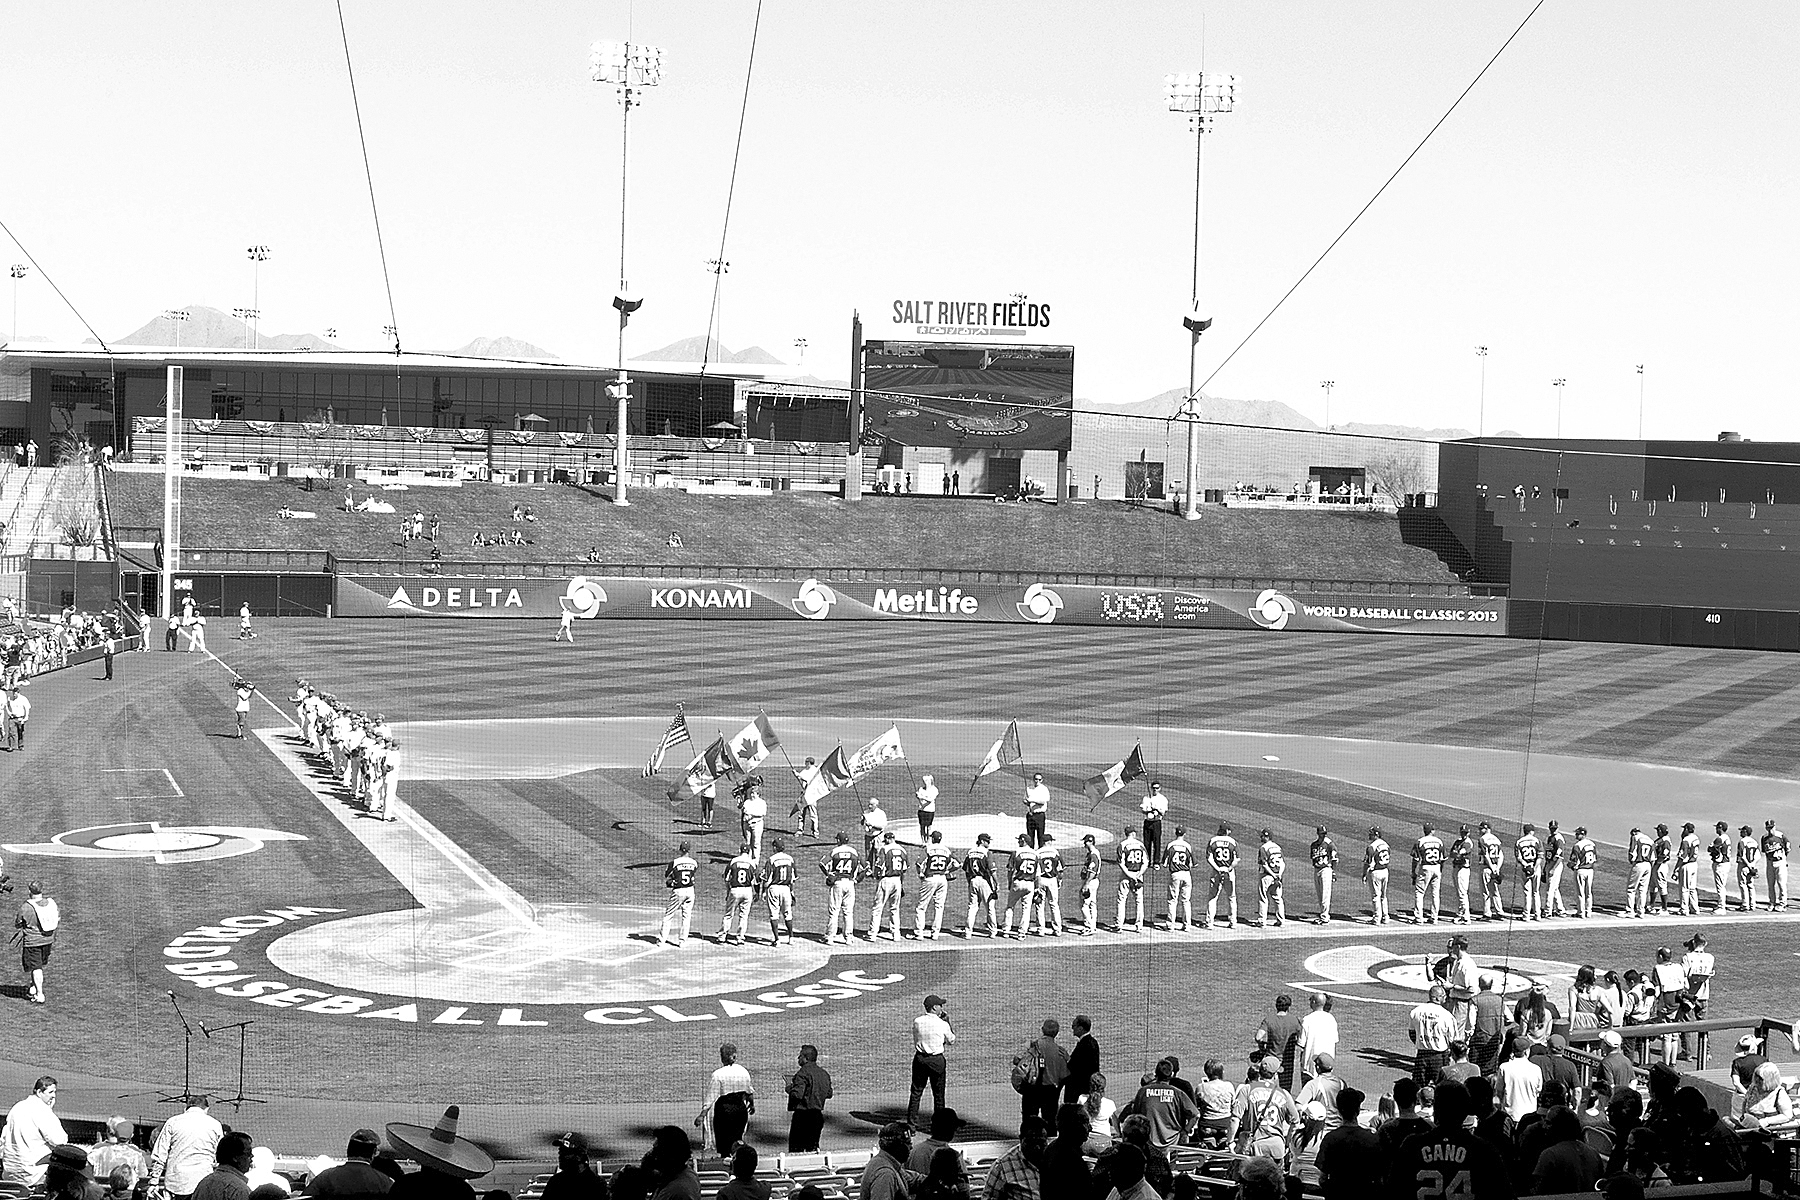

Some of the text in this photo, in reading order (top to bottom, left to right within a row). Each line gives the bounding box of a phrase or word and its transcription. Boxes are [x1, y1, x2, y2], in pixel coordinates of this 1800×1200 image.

[892, 300, 1051, 328] SALT RIVER FIELDS
[173, 578, 193, 590] 345
[422, 588, 524, 608] DELTA
[650, 588, 752, 609] KONAMI
[872, 586, 979, 615] MetLife
[1173, 596, 1211, 605] Discover
[1100, 591, 1165, 621] USA
[1173, 604, 1209, 613] America
[1302, 605, 1498, 622] WORLD BASEBALL CLASSIC 2013
[1173, 612, 1197, 620] .com
[1704, 613, 1722, 624] 410
[1127, 849, 1143, 864] 48
[1215, 847, 1231, 861] 39
[1522, 846, 1537, 860] 20
[835, 861, 853, 874] 44
[929, 856, 947, 871] 25
[1019, 859, 1035, 874] 45
[681, 871, 691, 885] 5
[737, 869, 747, 884] 8
[163, 905, 906, 1027] WORLD BASEBALL CLASSIC
[1145, 1088, 1175, 1098] PACIFICO
[1421, 1143, 1467, 1163] CANO
[1416, 1169, 1476, 1200] 24
